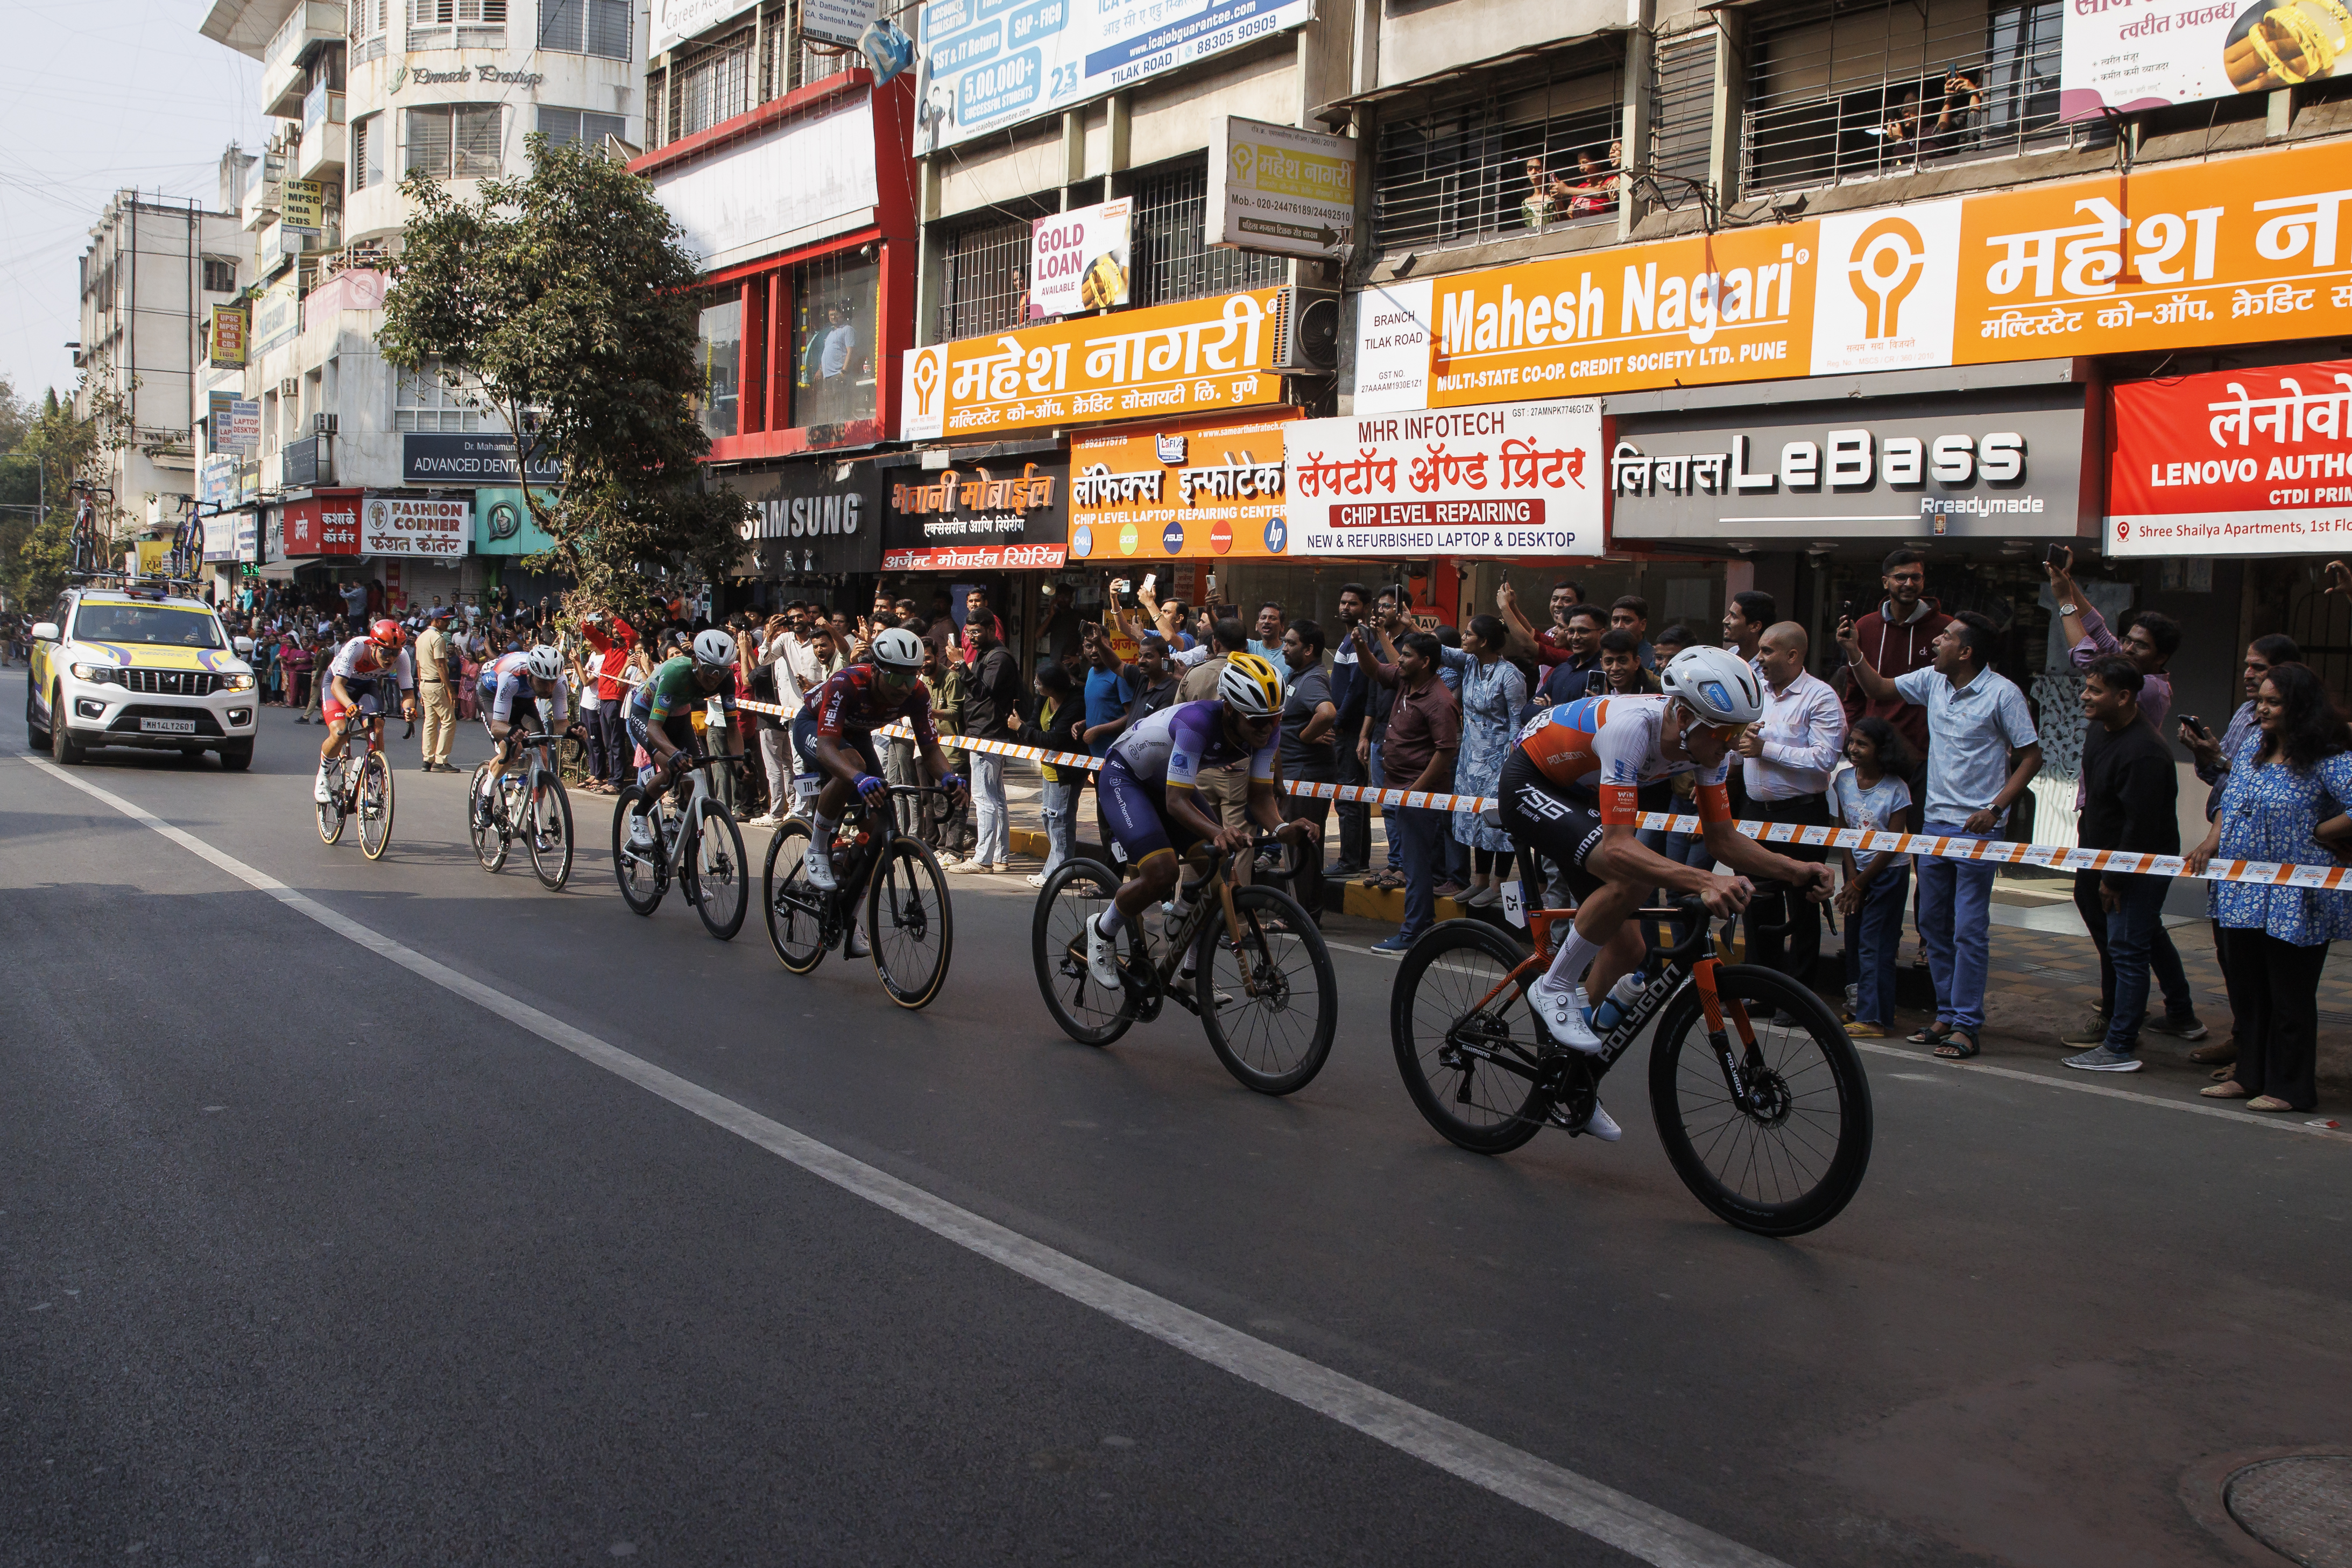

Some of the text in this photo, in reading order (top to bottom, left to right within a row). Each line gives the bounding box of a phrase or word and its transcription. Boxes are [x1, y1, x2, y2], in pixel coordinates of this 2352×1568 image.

[820, 1, 849, 16] Dattatray
[850, 9, 866, 18] Mule
[931, 0, 964, 24] ACCOUNTS
[1124, 10, 1135, 28] सी
[805, 10, 863, 30] CA. Santosh More
[927, 10, 967, 39] FINALISATION
[1014, 2, 1062, 39] SAP FICO
[1129, 1, 1256, 58] www.icajobguarantee.com
[2120, 12, 2171, 40] त्वरीत
[2176, 1, 2237, 29] उपलब्ध
[802, 27, 832, 40] CHARTERED
[933, 31, 999, 72] GST IT Return
[1111, 15, 1276, 84] TILAK ROAD 88305 90909
[2101, 52, 2139, 66] त्वरीत मंजूर
[411, 65, 543, 90] Pinnacle Prestige
[964, 56, 1034, 104] 5,00,000+
[2100, 62, 2169, 81] कमीत कमी व्याजदर
[964, 84, 1033, 121] SUCCESSFUL STUDENTS
[966, 108, 1030, 135] www.icajobguarantee.com
[1259, 150, 1351, 189] महेश नागरी
[288, 181, 318, 192] UPSC
[288, 193, 320, 204] MPSC
[288, 206, 310, 214] NDA
[1256, 197, 1350, 222] 020-24476189/24492510
[288, 216, 310, 225] CDS
[1242, 220, 1318, 239] पहिला मजला टिळक रोड शाखा
[1038, 223, 1084, 253] GOLD
[1985, 195, 2225, 299] महेश
[1038, 250, 1082, 280] LOAN
[1041, 281, 1075, 296] AVAILABLE
[1441, 242, 1795, 356] Mahesh Nagari
[1374, 310, 1415, 327] BRANCH
[1981, 307, 2083, 341] मल्टिस्टेट
[2096, 293, 2215, 331] को-ऑप.
[2231, 281, 2315, 319] क्रेडिट
[222, 340, 236, 348] CDS
[952, 294, 1266, 401] महेश नागरी
[1365, 332, 1422, 350] TILAK ROAD
[1846, 337, 1916, 352] सत्यम सदा विजयते
[1436, 340, 1787, 393] MULTI-STATE CO-OP. CREDIT SOCIETY LTD. PUNE
[1859, 357, 1878, 365] MSCS
[1379, 370, 1405, 380] GST NO.
[949, 376, 1259, 429] मल्टिस्टेट क्रेडिट सोसायटी लि. पुणे
[1512, 408, 1525, 418] GST
[1359, 411, 1504, 443] MHR INFOTECH
[464, 442, 475, 450] Dr.
[1085, 435, 1127, 448] 9921775775
[414, 458, 532, 474] ADVANCED DENTAL
[1296, 436, 1586, 498] लॅपटॉप प्रिंटर
[1610, 428, 2024, 491] लिबास LeBass
[1178, 450, 1282, 506] इन्फोटेक
[2152, 458, 2258, 487] LENOVO
[892, 463, 1054, 515] भवानी मोबाईल
[2269, 489, 2309, 505] CTDI
[392, 502, 462, 517] FASHION
[741, 493, 860, 540] SAMSUNG
[1073, 505, 1287, 525] CHIP LEVEL LAPTOP REPAIRING CENTER
[1341, 502, 1530, 525] CHIP LEVEL REPAIRING
[1921, 495, 2044, 518] Rreadymade
[322, 508, 356, 526] कशाळे
[394, 517, 460, 532] CORNER
[924, 515, 993, 537] एक्सेसरीज आणि
[323, 528, 356, 543] कॉर्नर
[2139, 519, 2330, 538] Shree Shailya Apartments, 1st
[368, 531, 461, 553] फॅशन कॉर्नर
[1074, 535, 1092, 547] DELL
[1120, 535, 1138, 543] acer
[1163, 533, 1183, 542] ASUS
[1308, 532, 1576, 548] NEW & REFURBISHED LAPTOP & DESKTOP
[936, 547, 998, 568] मोबाईल
[1001, 545, 1064, 565] रिपेरिंग
[146, 721, 193, 730] MH14LY2601
[1546, 751, 1587, 765] POLYGON
[1505, 893, 1520, 913] 25
[887, 980, 901, 1000] SWISS
[1597, 963, 1681, 1063] POLYGON
[1461, 1044, 1491, 1059] SHIMANO
[1725, 1051, 1744, 1098] POLYGON
